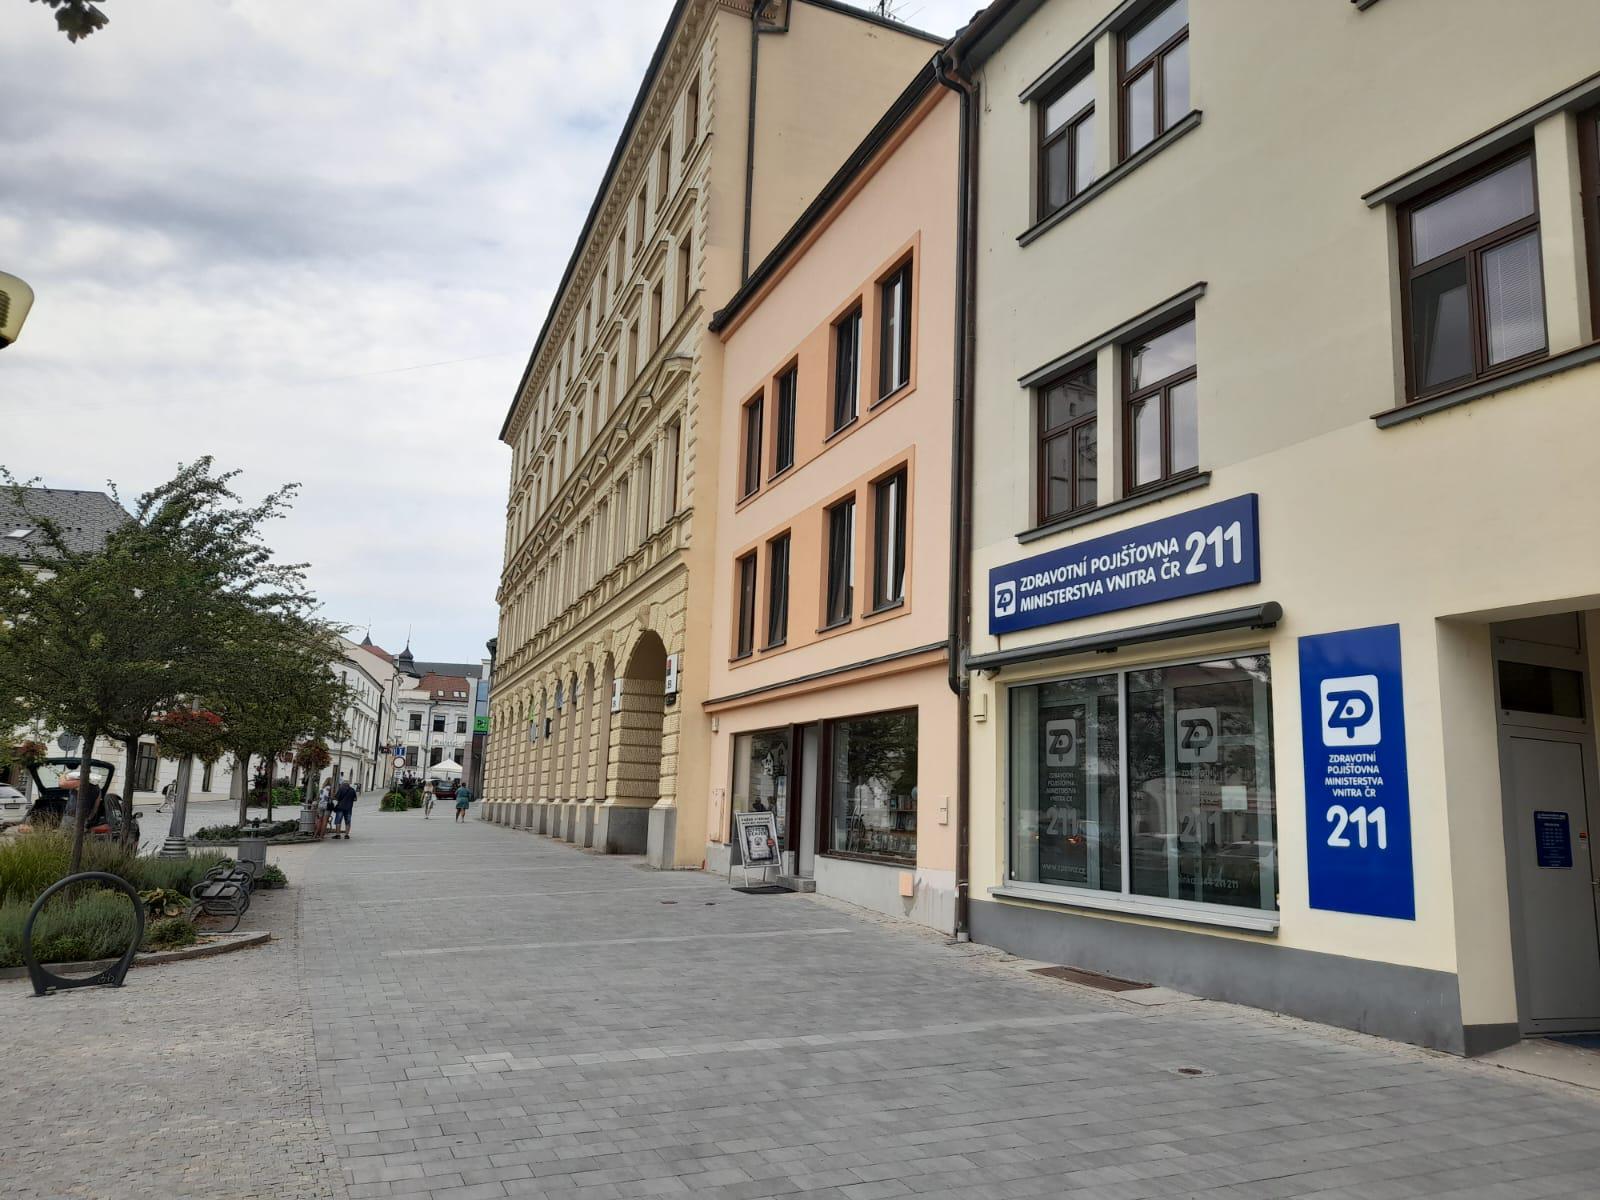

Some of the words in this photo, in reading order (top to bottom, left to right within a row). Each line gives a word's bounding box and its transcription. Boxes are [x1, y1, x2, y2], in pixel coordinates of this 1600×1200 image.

[1185, 521, 1242, 575] 211
[1020, 555, 1087, 592] ZDRAVOTNÍ
[1091, 537, 1180, 574] POJIŠŤOVNA
[1020, 579, 1104, 612] MINISTERSTVA
[1106, 566, 1157, 592] VNITRA
[1160, 557, 1181, 580] ČR
[1327, 763, 1380, 775] POJIŠŤOVNA
[1328, 751, 1377, 763] ZDRAVOTNÍ
[1324, 776, 1384, 786] MINISTERSTVA
[1332, 788, 1362, 797] VNITRA
[1364, 786, 1377, 798] ČR
[1046, 806, 1079, 836] 211
[1180, 811, 1221, 846] 211
[1326, 804, 1387, 850] 211
